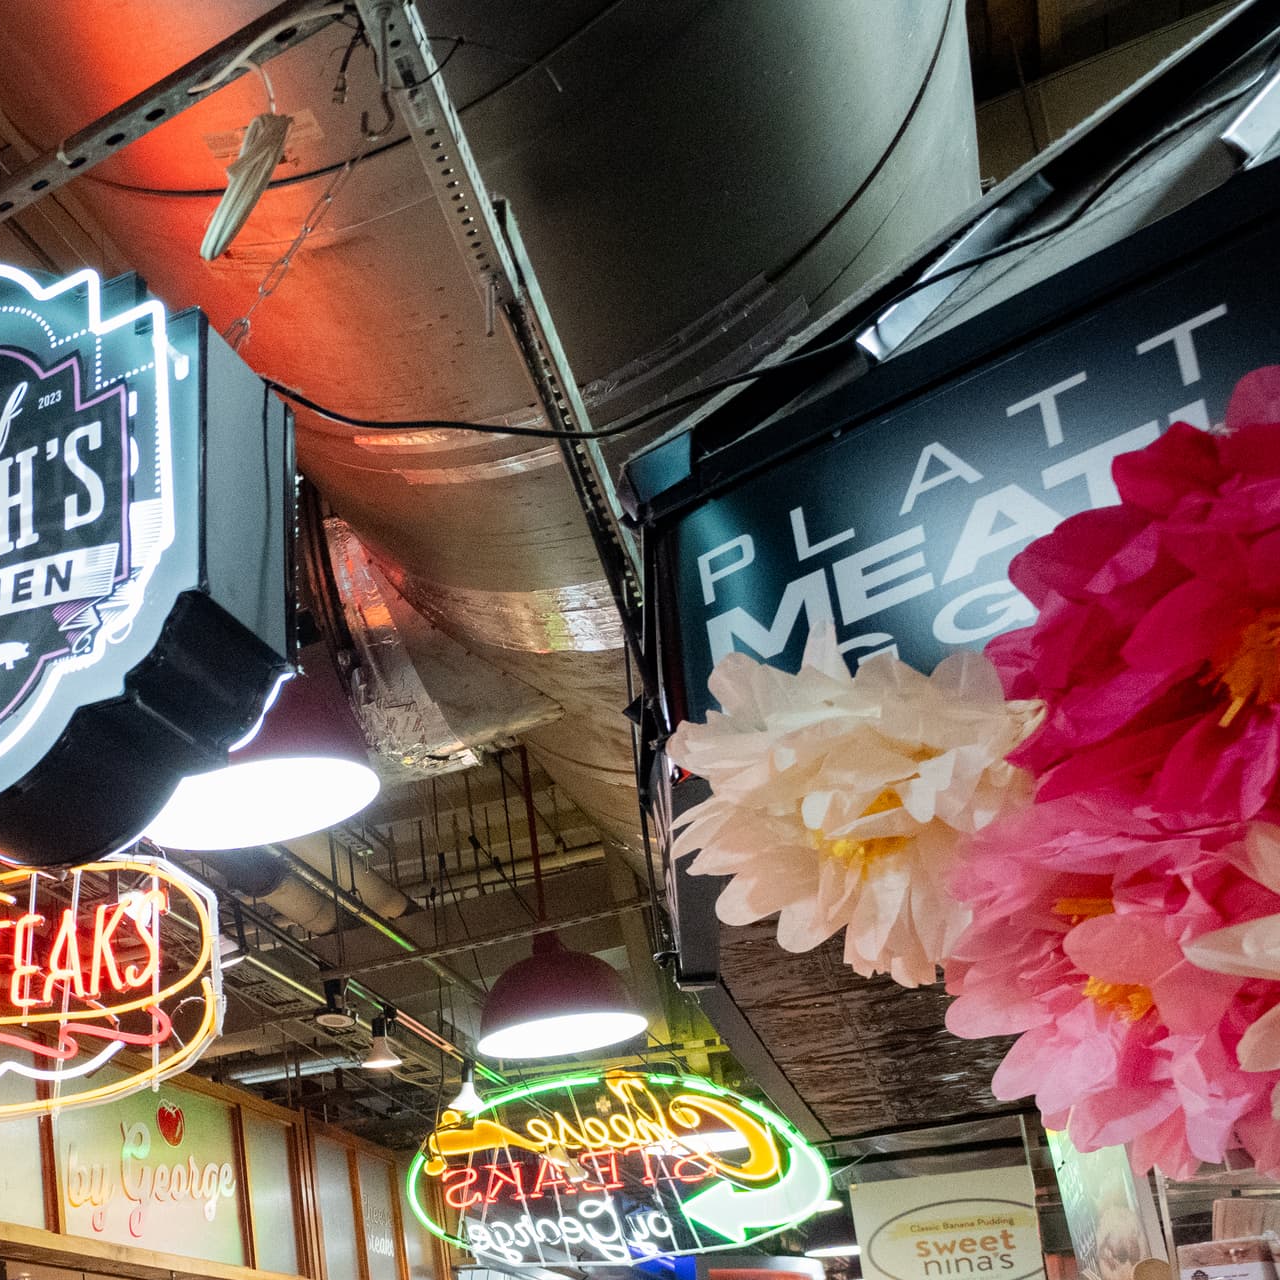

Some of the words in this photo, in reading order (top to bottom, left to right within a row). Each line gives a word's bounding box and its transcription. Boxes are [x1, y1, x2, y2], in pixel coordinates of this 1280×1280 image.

[36, 390, 63, 410] 2023
[120, 1121, 237, 1238] George
[909, 1221, 939, 1233] Classic
[941, 1218, 974, 1230] Banana
[976, 1215, 1015, 1228] Pudding
[915, 1229, 1016, 1258] sweet
[923, 1249, 1015, 1273] nina's
